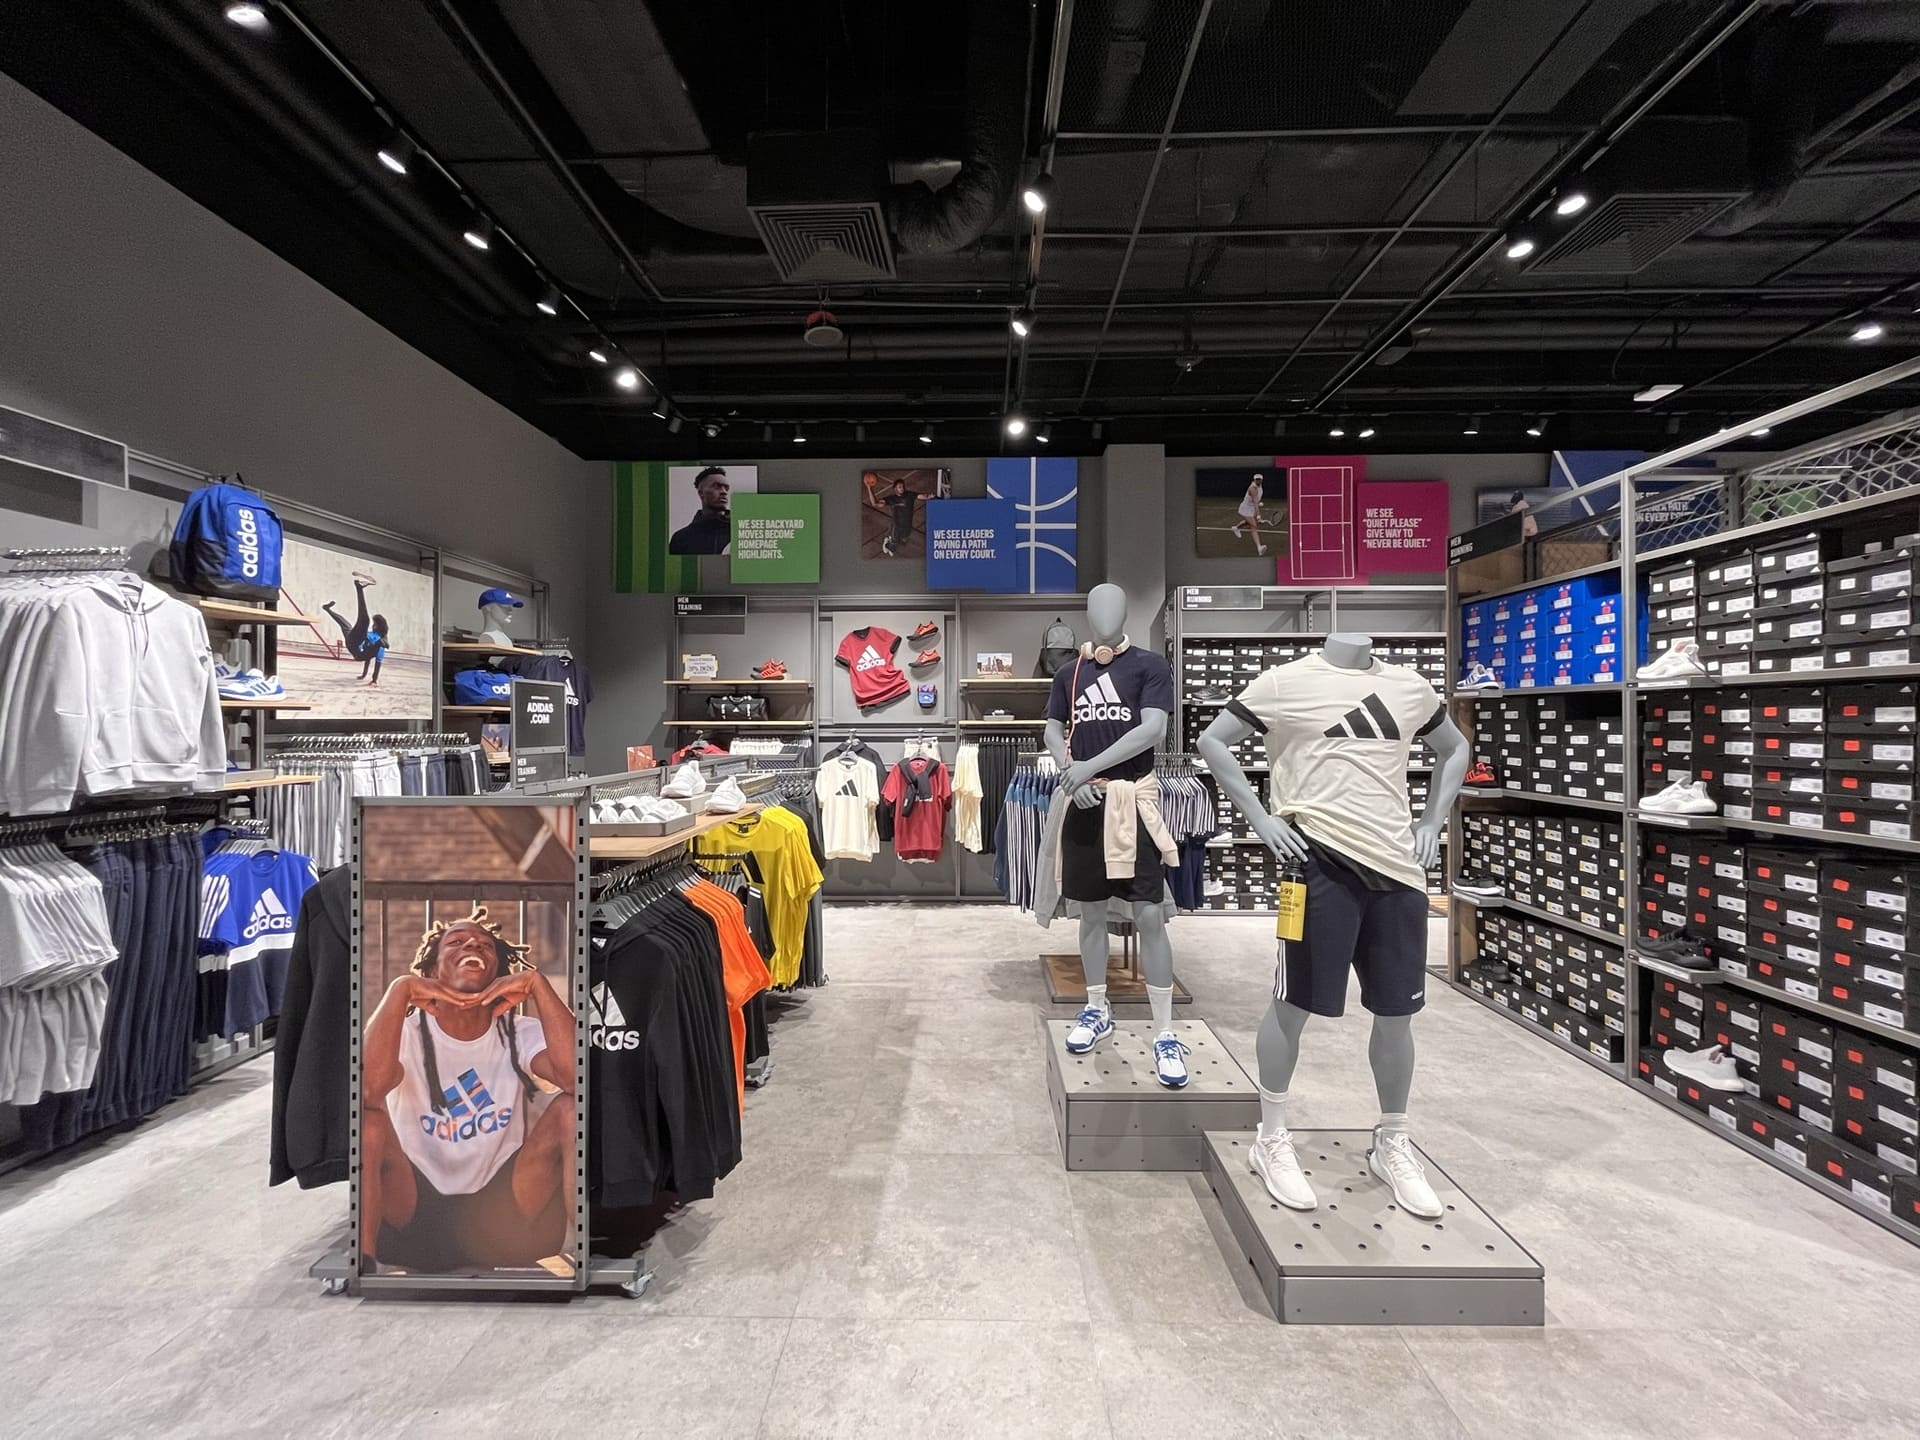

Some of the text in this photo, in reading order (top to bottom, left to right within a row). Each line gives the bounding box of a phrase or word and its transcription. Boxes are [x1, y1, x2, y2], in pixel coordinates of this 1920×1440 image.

[1366, 508, 1394, 518] WE SEE
[738, 519, 804, 529] WE SEE BACKYARD
[738, 529, 795, 539] MOVES BECOME
[933, 529, 994, 539] WE SEE LEADERS
[1366, 528, 1414, 538] GIVE WAY TO
[236, 508, 259, 578] adidas
[738, 539, 778, 549] HOMEPAGE
[933, 539, 987, 549] PAVING A PATH
[1392, 538, 1402, 548] BE
[738, 549, 784, 559] HIGHLIGHTS.
[933, 549, 996, 559] ON EVERY COURT.
[856, 657, 886, 672] adidas
[492, 683, 511, 695] adi
[527, 702, 554, 713] ADIDAS
[1073, 703, 1132, 724] adidas
[530, 714, 550, 724] .COM
[243, 914, 293, 939] adidas
[589, 1025, 640, 1051] idas
[420, 1107, 512, 1142] adidas
